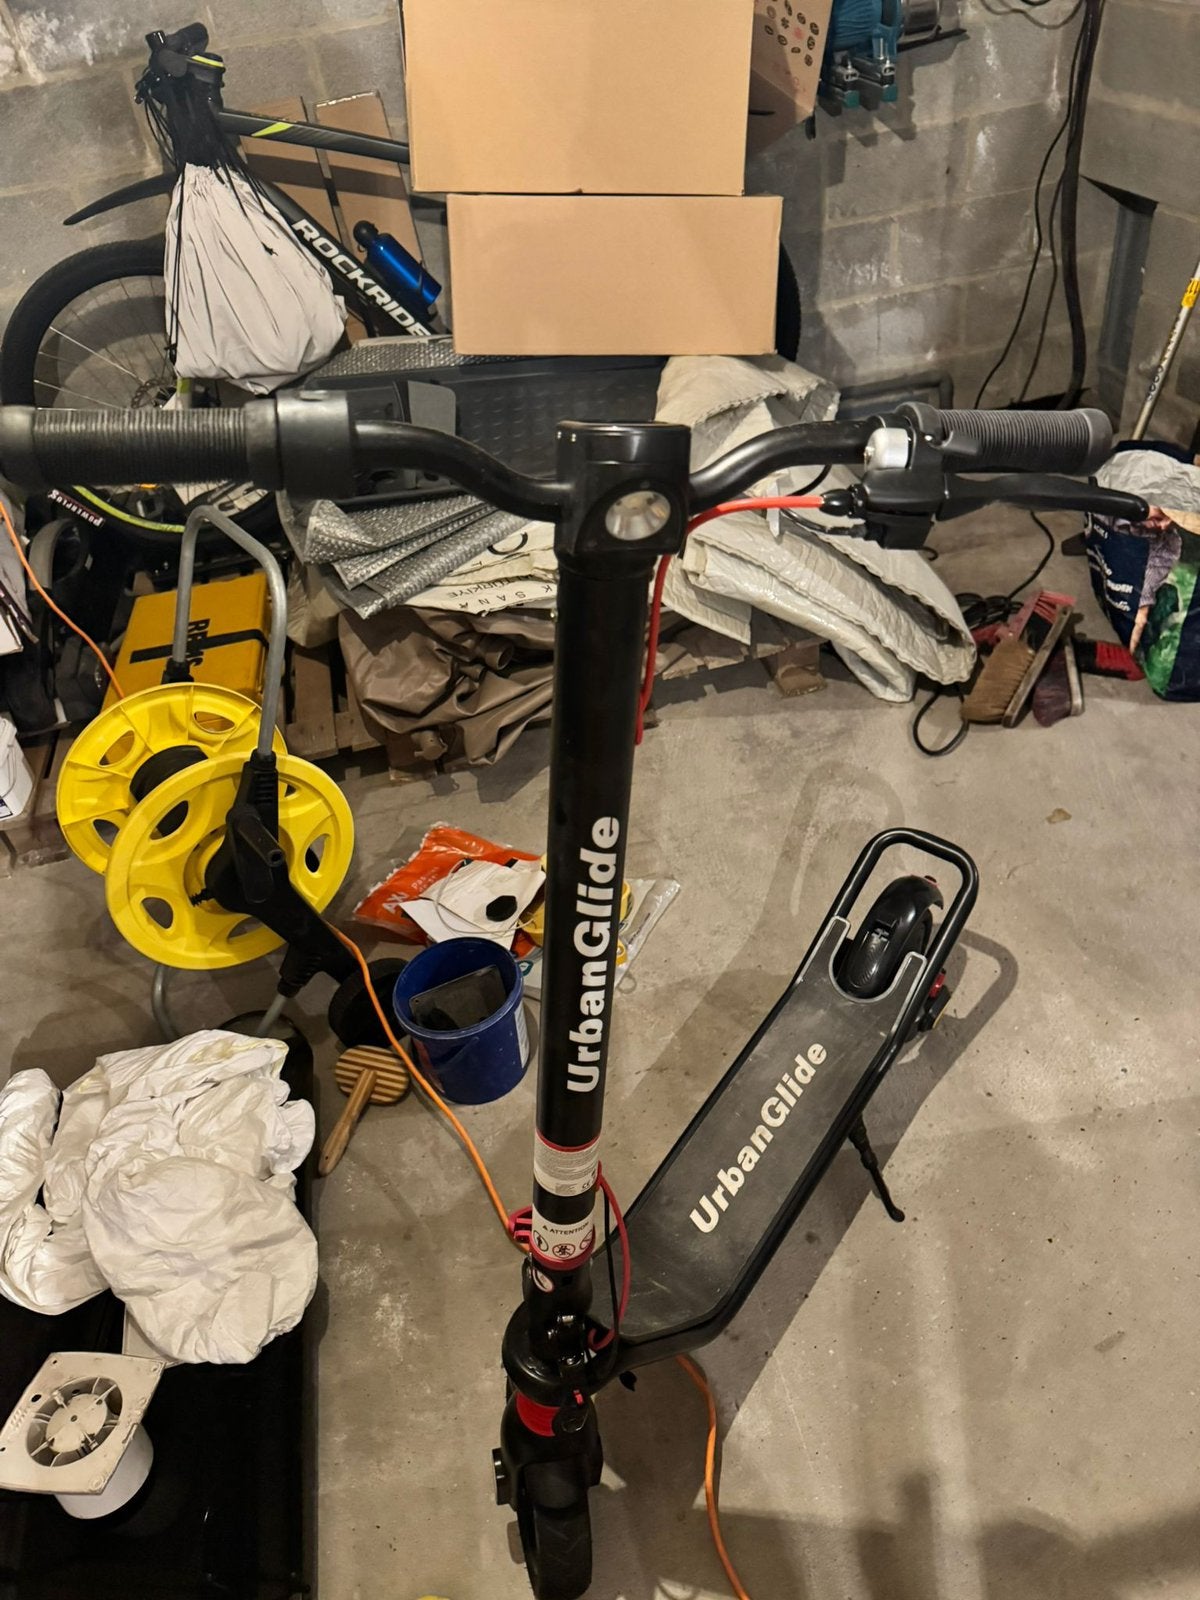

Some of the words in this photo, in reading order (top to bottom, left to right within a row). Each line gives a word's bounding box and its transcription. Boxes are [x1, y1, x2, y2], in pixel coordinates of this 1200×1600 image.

[185, 618, 211, 667] RES
[567, 816, 620, 1093] UrbanGlide
[689, 1043, 828, 1233] UrbanGlide
[549, 1221, 590, 1235] ATTENTION
